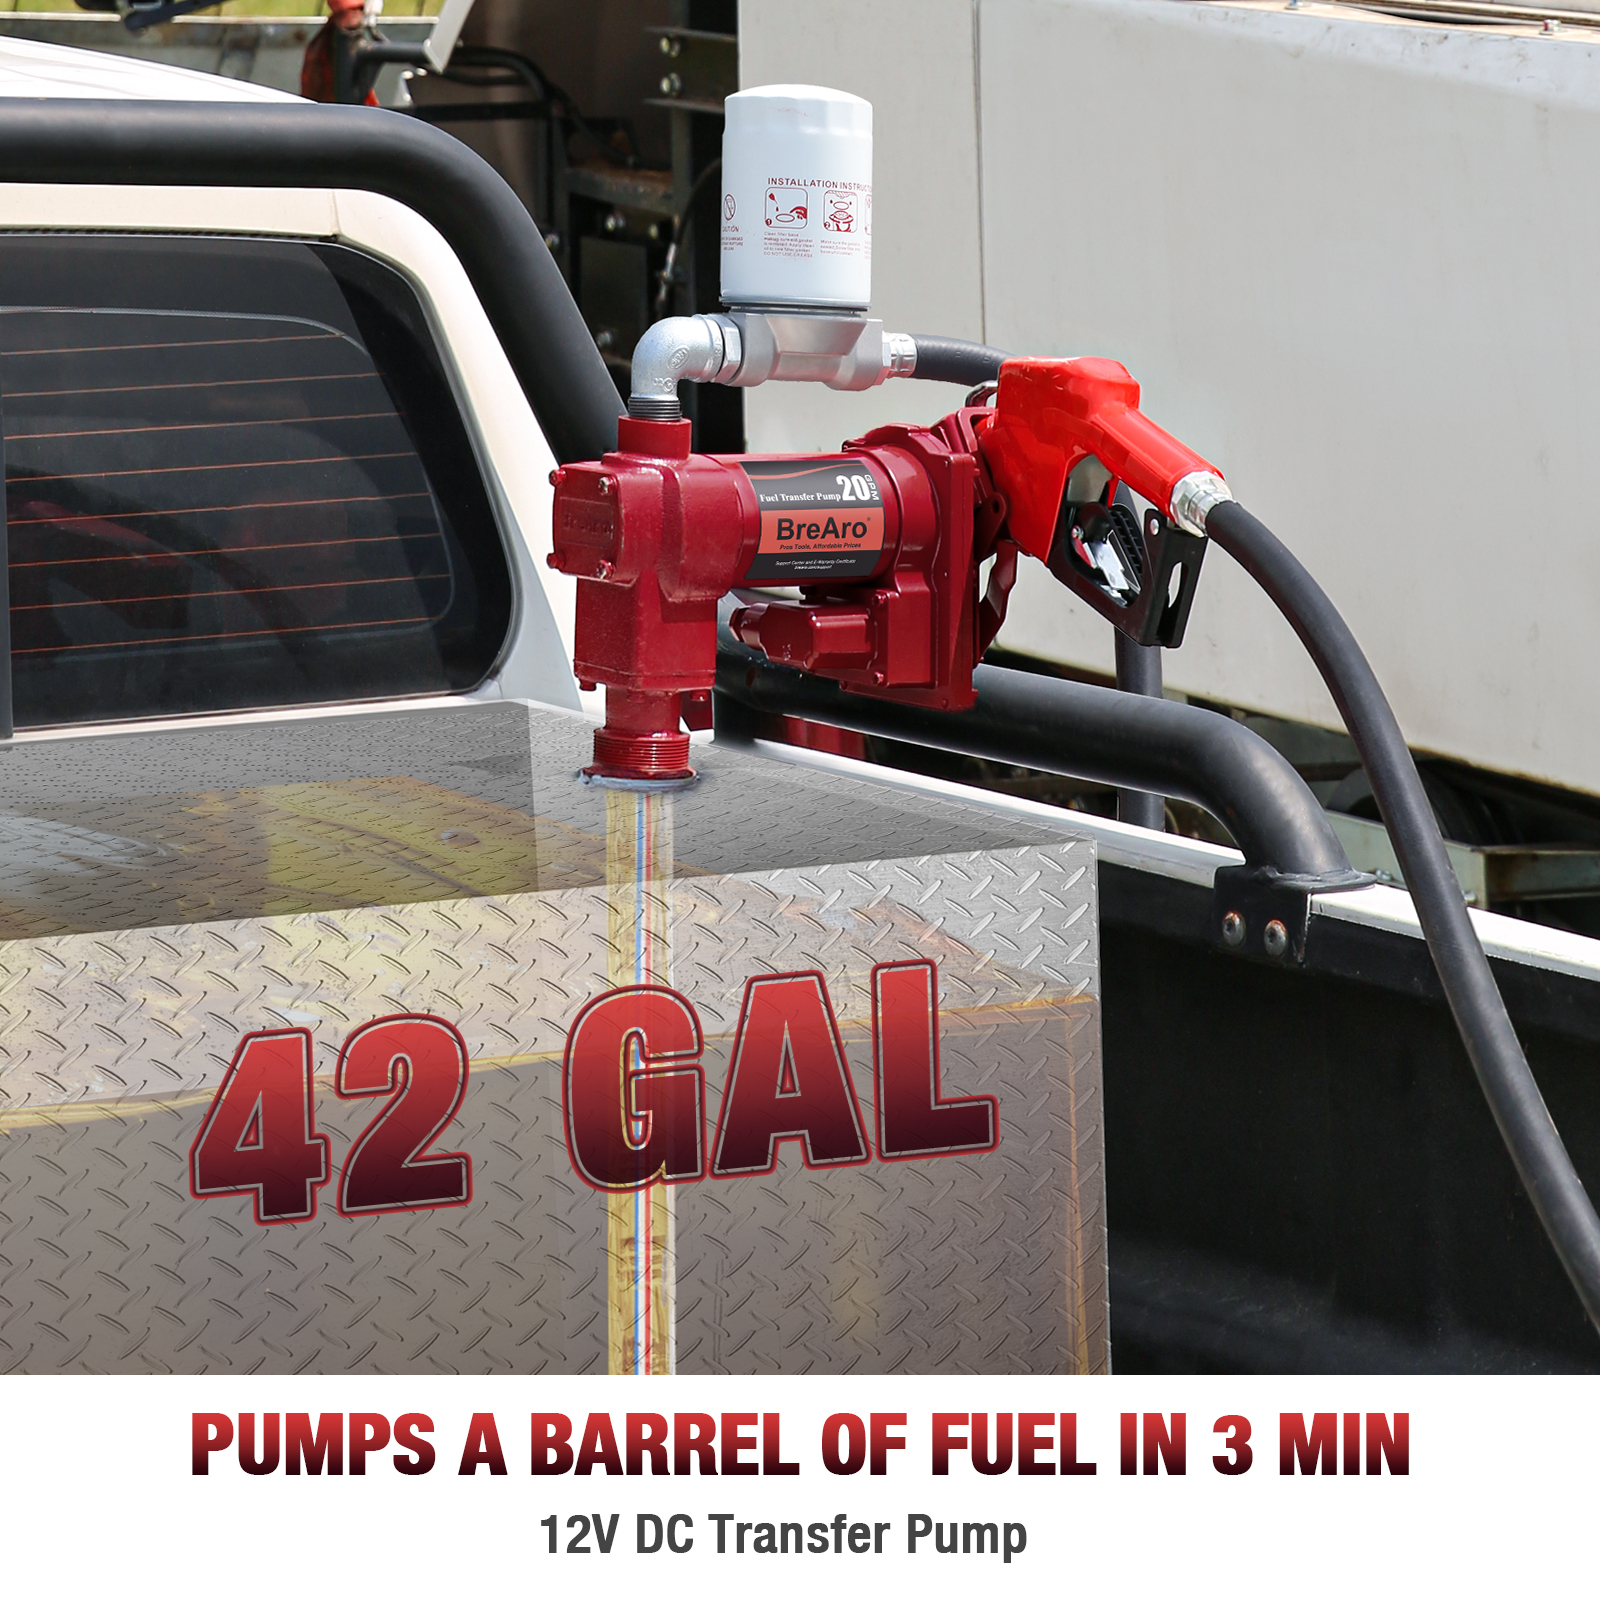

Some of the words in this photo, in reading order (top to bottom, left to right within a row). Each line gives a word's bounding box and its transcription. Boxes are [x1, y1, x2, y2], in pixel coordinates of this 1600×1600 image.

[768, 177, 838, 189] INSTALLATION
[759, 493, 779, 502] Fuel
[780, 493, 815, 502] Transfer
[816, 492, 841, 502] Pump
[835, 474, 871, 501] 20
[864, 474, 880, 501] GPM
[776, 516, 868, 541] BreAro
[813, 542, 843, 550] Affordable
